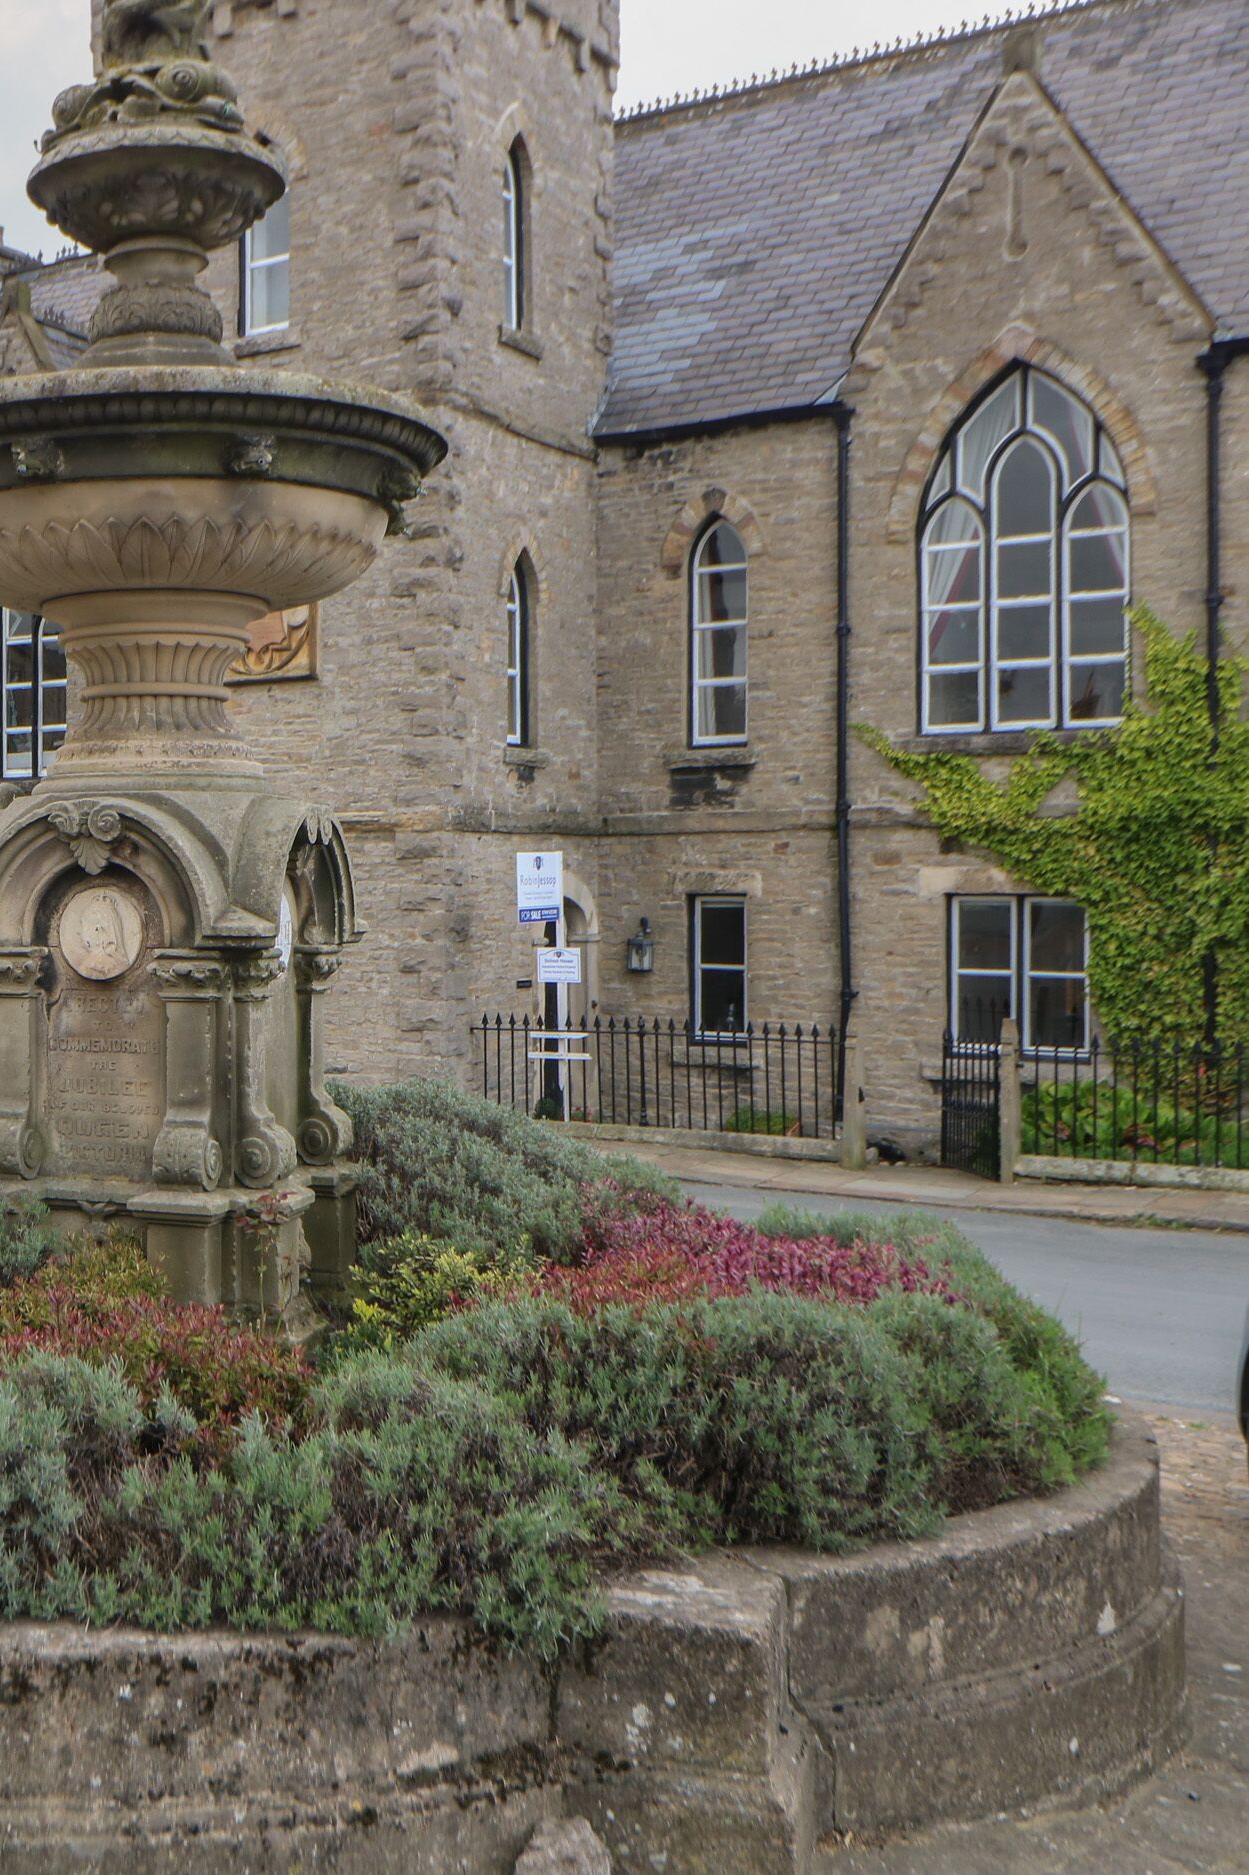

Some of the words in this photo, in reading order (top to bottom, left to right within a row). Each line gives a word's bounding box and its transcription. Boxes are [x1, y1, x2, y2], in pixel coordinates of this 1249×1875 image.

[521, 910, 530, 921] FOR
[531, 909, 541, 921] SALE
[94, 1021, 113, 1032] TO
[49, 1038, 161, 1055] COMMEMORATE
[91, 1061, 117, 1072] THE
[58, 1078, 150, 1097] JUBILEE
[71, 1101, 96, 1113] OUR
[101, 1103, 160, 1116] BELOVED
[56, 1119, 151, 1140] QUEEN
